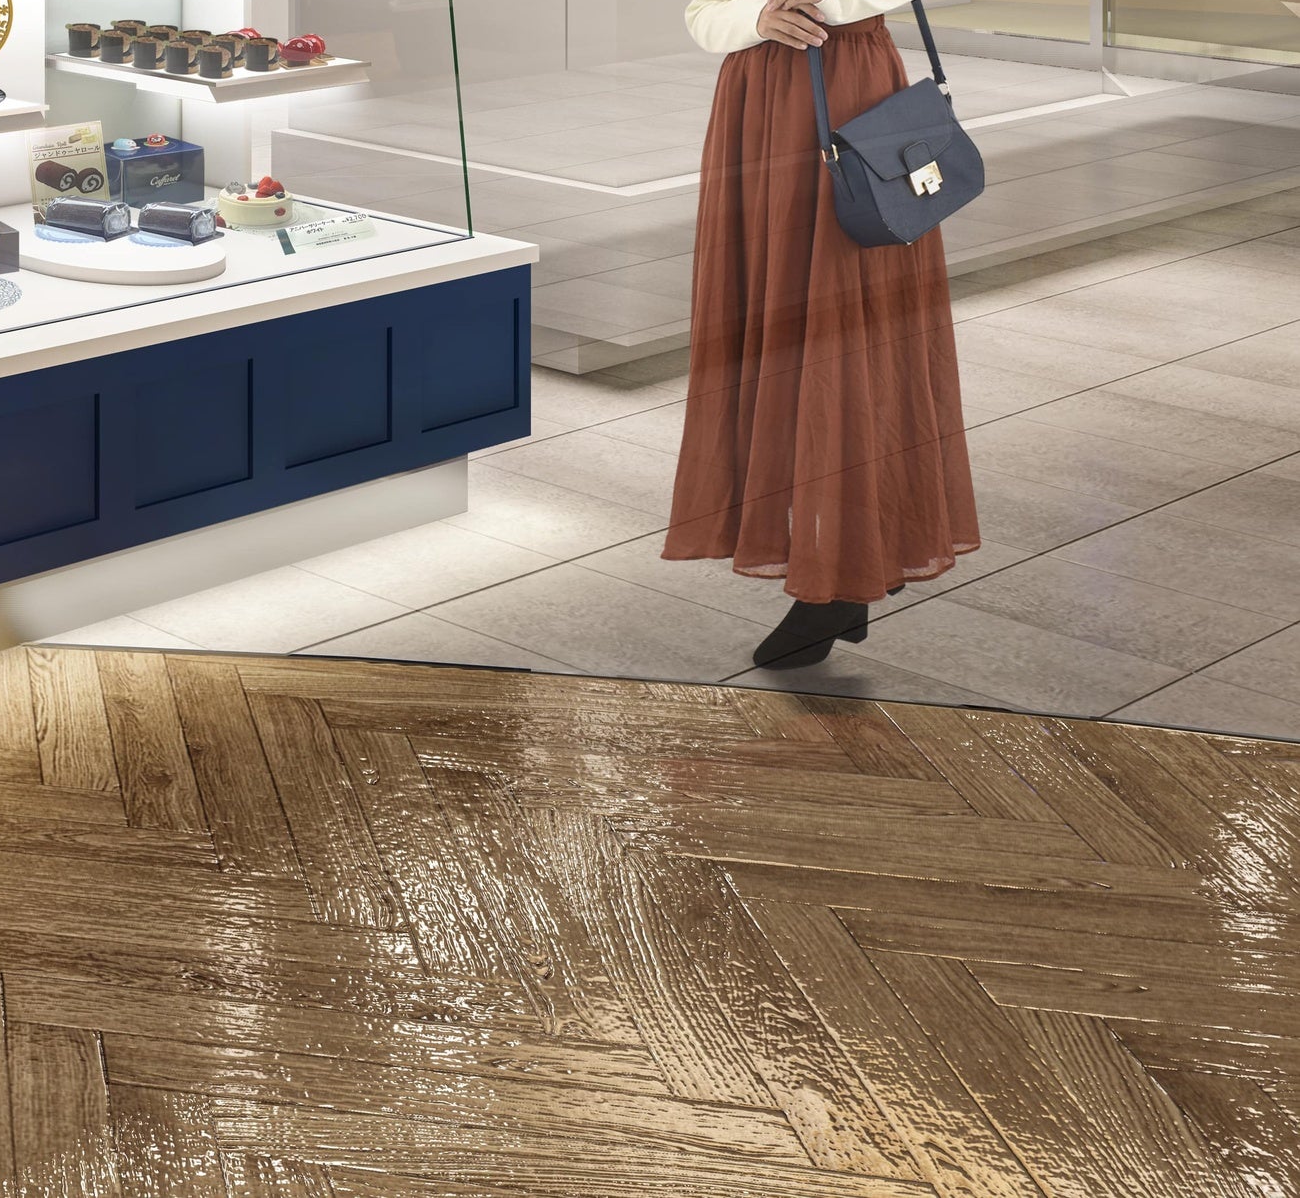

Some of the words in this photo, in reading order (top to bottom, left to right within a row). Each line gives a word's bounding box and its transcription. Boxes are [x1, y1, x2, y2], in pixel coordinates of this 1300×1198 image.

[34, 146, 101, 159] ジャンドゥーヤロール
[150, 173, 181, 188] Caffarel
